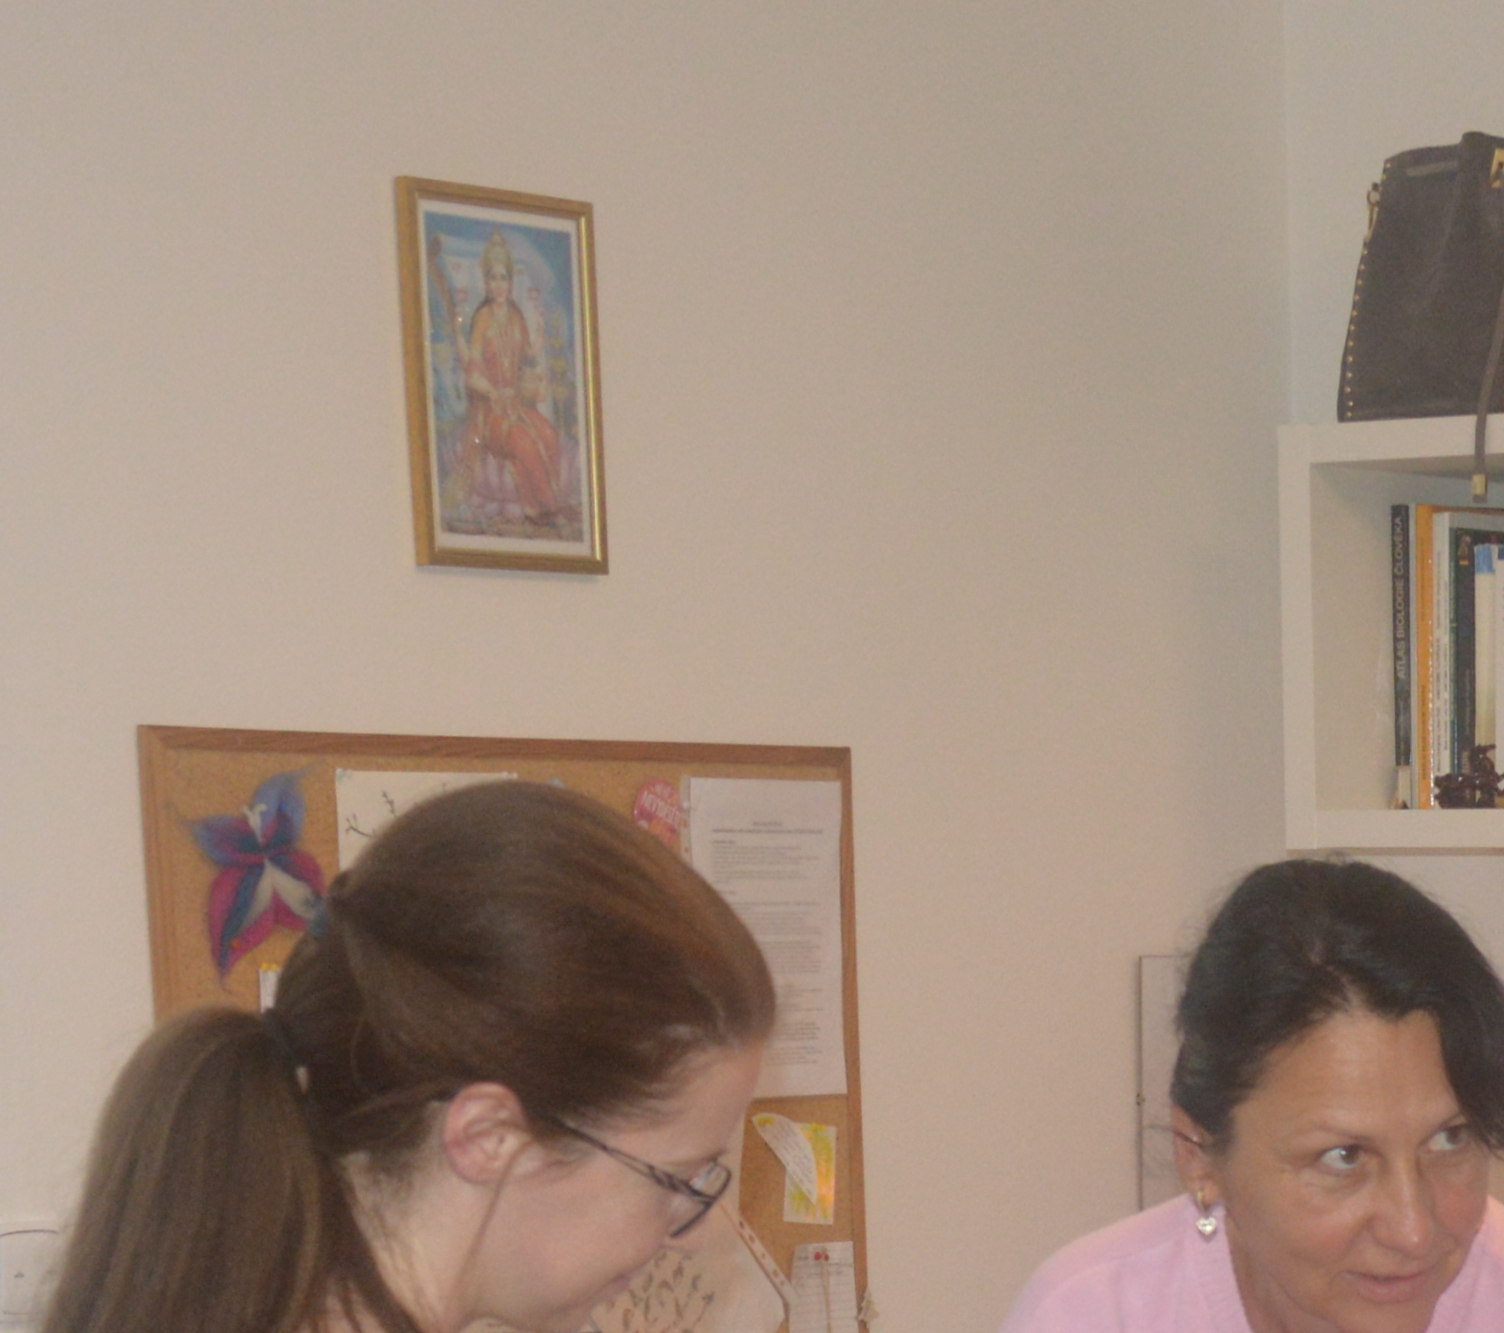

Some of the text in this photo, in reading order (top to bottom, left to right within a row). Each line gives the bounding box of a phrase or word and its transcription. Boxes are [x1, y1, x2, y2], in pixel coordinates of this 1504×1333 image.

[1393, 517, 1406, 679] ATLAS BIOLOGIE ČLOVĚKA
